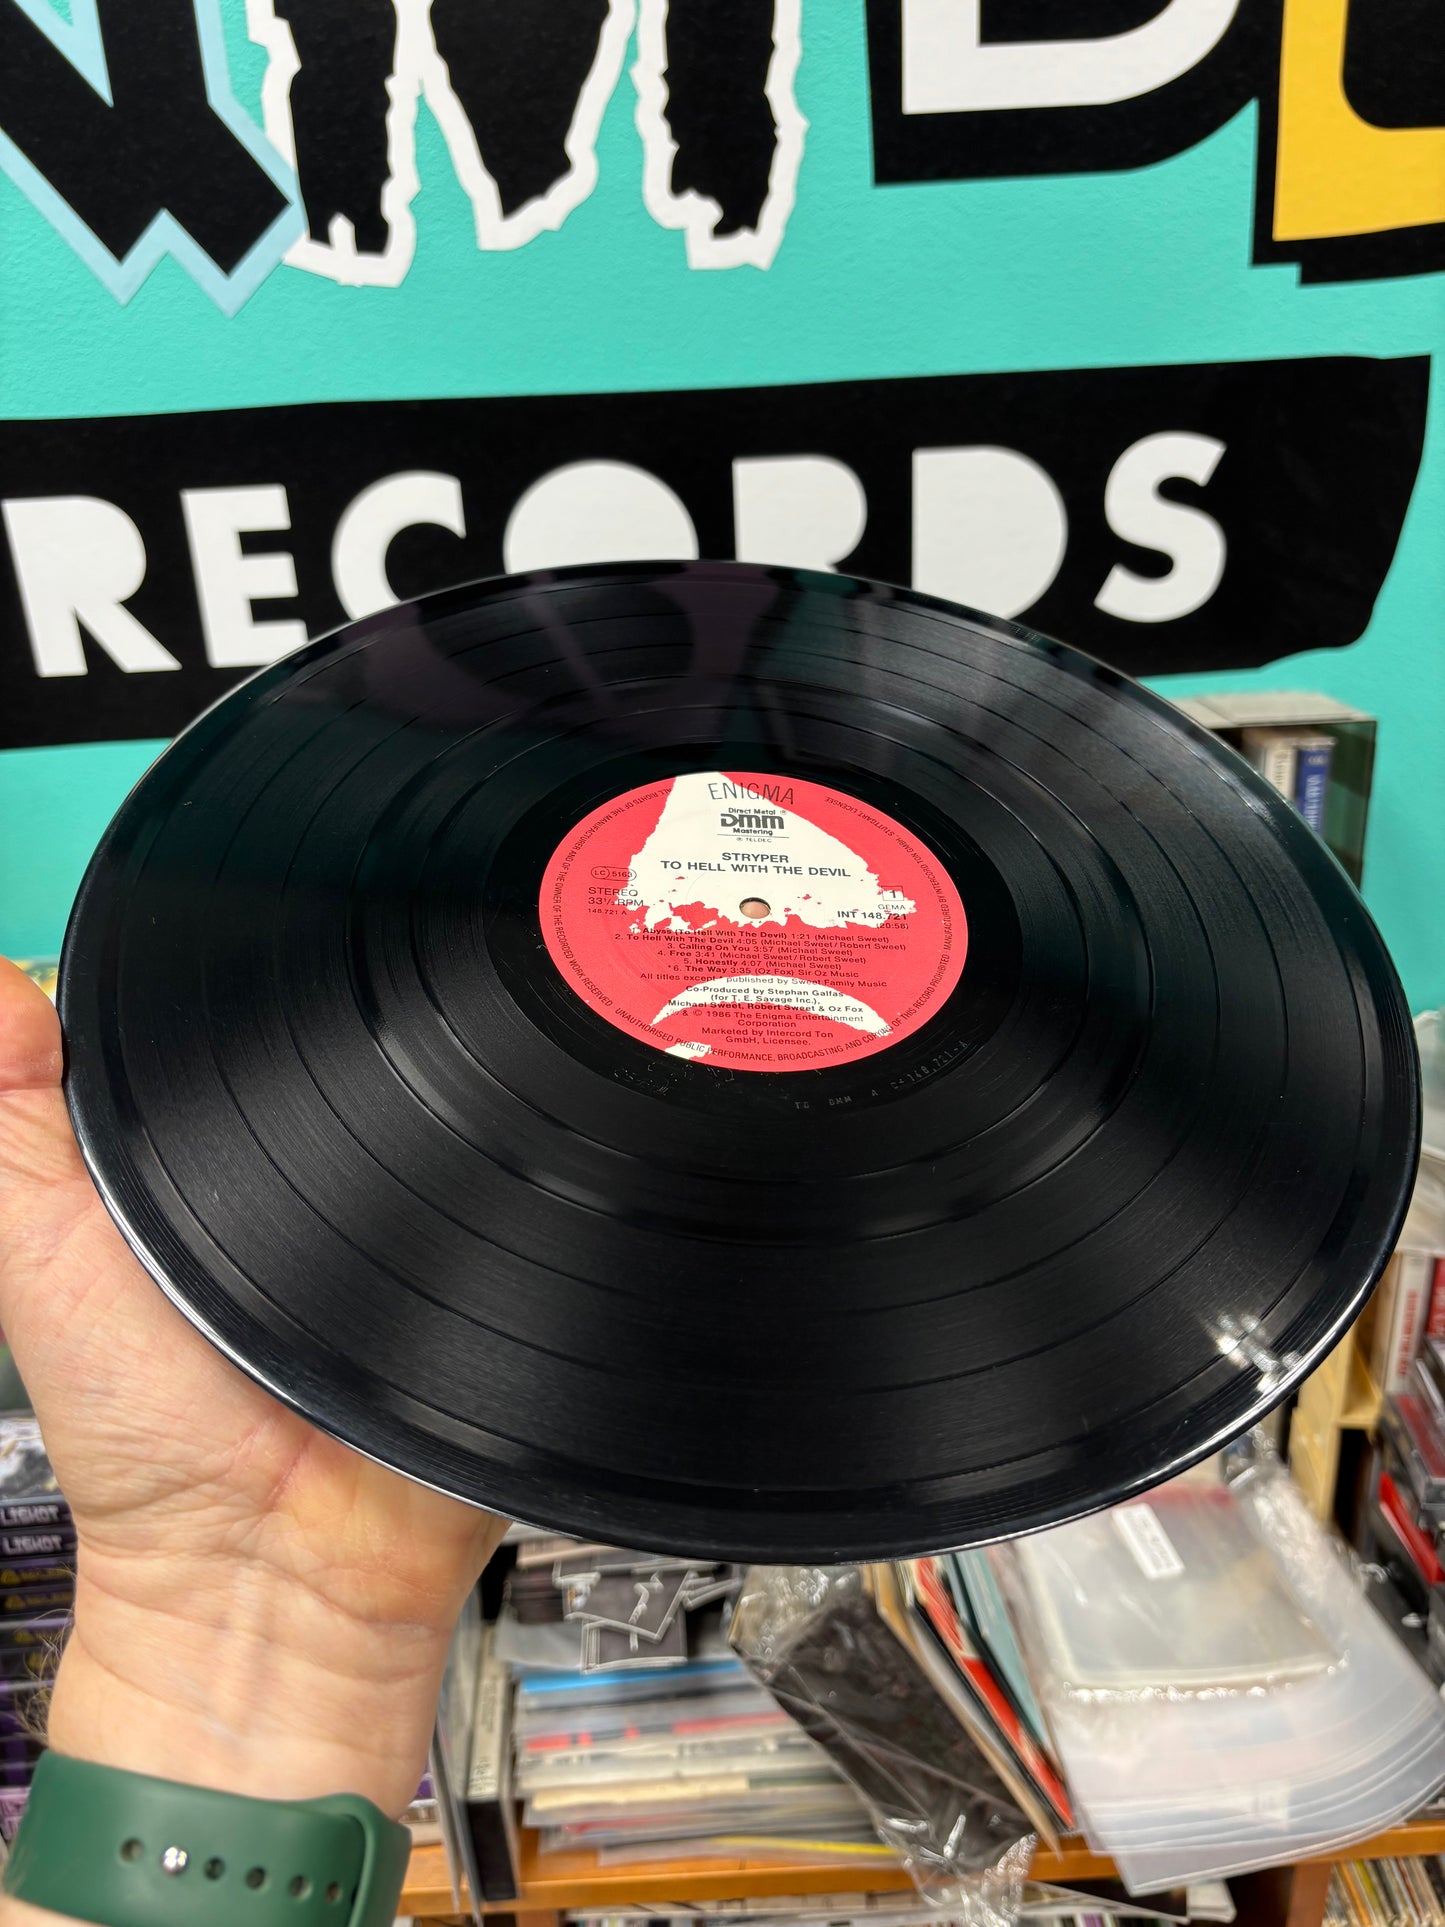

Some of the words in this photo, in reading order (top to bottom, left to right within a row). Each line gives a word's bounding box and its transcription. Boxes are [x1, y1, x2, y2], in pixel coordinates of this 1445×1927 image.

[660, 788, 672, 796] ALL
[707, 782, 795, 804] ENIGMA
[633, 792, 659, 806] RIGHTS
[610, 806, 626, 817] THE
[625, 802, 634, 810] OF
[572, 815, 613, 850] MANUFACTURER
[732, 828, 773, 836] Mastering
[565, 850, 577, 862] AND
[722, 852, 790, 863] STRYPER
[911, 853, 922, 864] TON
[562, 862, 570, 871] OF
[660, 860, 682, 870] TO
[687, 862, 726, 872] HELL
[731, 864, 768, 874] WITH
[773, 866, 803, 875] THE
[808, 867, 851, 877] DEVIL
[558, 870, 568, 882] THE
[920, 864, 942, 894] INTERCORD
[553, 883, 564, 904] OWNER
[588, 886, 638, 897] STEREO
[890, 890, 896, 898] 1
[617, 898, 644, 907] RPM
[939, 894, 947, 903] BY
[553, 905, 560, 913] OF
[554, 914, 563, 926] THE
[837, 910, 857, 918] INT
[861, 912, 906, 920] 148.721
[942, 904, 953, 951] MANUFACTURED
[555, 926, 574, 959] RECORDED
[814, 934, 854, 942] (Michael
[820, 948, 853, 956] Sweet)
[696, 959, 738, 967] Honestly
[810, 962, 842, 970] Sweet)
[834, 956, 866, 964] Sweet)
[569, 959, 586, 978] WORK
[706, 966, 728, 974] Way
[684, 974, 716, 982] except
[726, 976, 774, 984] published
[824, 980, 855, 988] Family
[582, 977, 613, 1007] RESERVED
[686, 986, 750, 994] Co-Produced
[768, 988, 809, 996] Stephan
[615, 1007, 674, 1042] UNAUTHORISED
[674, 1037, 705, 1053] PUBLIC
[706, 1046, 776, 1062] PERFORMANCE,
[778, 1044, 844, 1061] BROADCASTING
[845, 1038, 862, 1050] AND
[862, 1024, 893, 1043] COPYING
[892, 1016, 902, 1028] OF
[900, 1007, 918, 1021] THIS
[913, 986, 936, 1010] RECORD
[930, 953, 950, 987] PROHIBITED
[668, 1000, 707, 1008] Michael
[748, 1003, 781, 1011] Robert
[784, 1004, 815, 1012] Sweet
[756, 1012, 792, 1020] Enigma
[795, 1014, 864, 1022] Entertainment
[738, 1020, 796, 1028] Corporation
[701, 1027, 749, 1036] Marketed
[766, 1029, 813, 1037] Intercord
[726, 1036, 760, 1044] GmbH,
[762, 1038, 811, 1046] Licensee.
